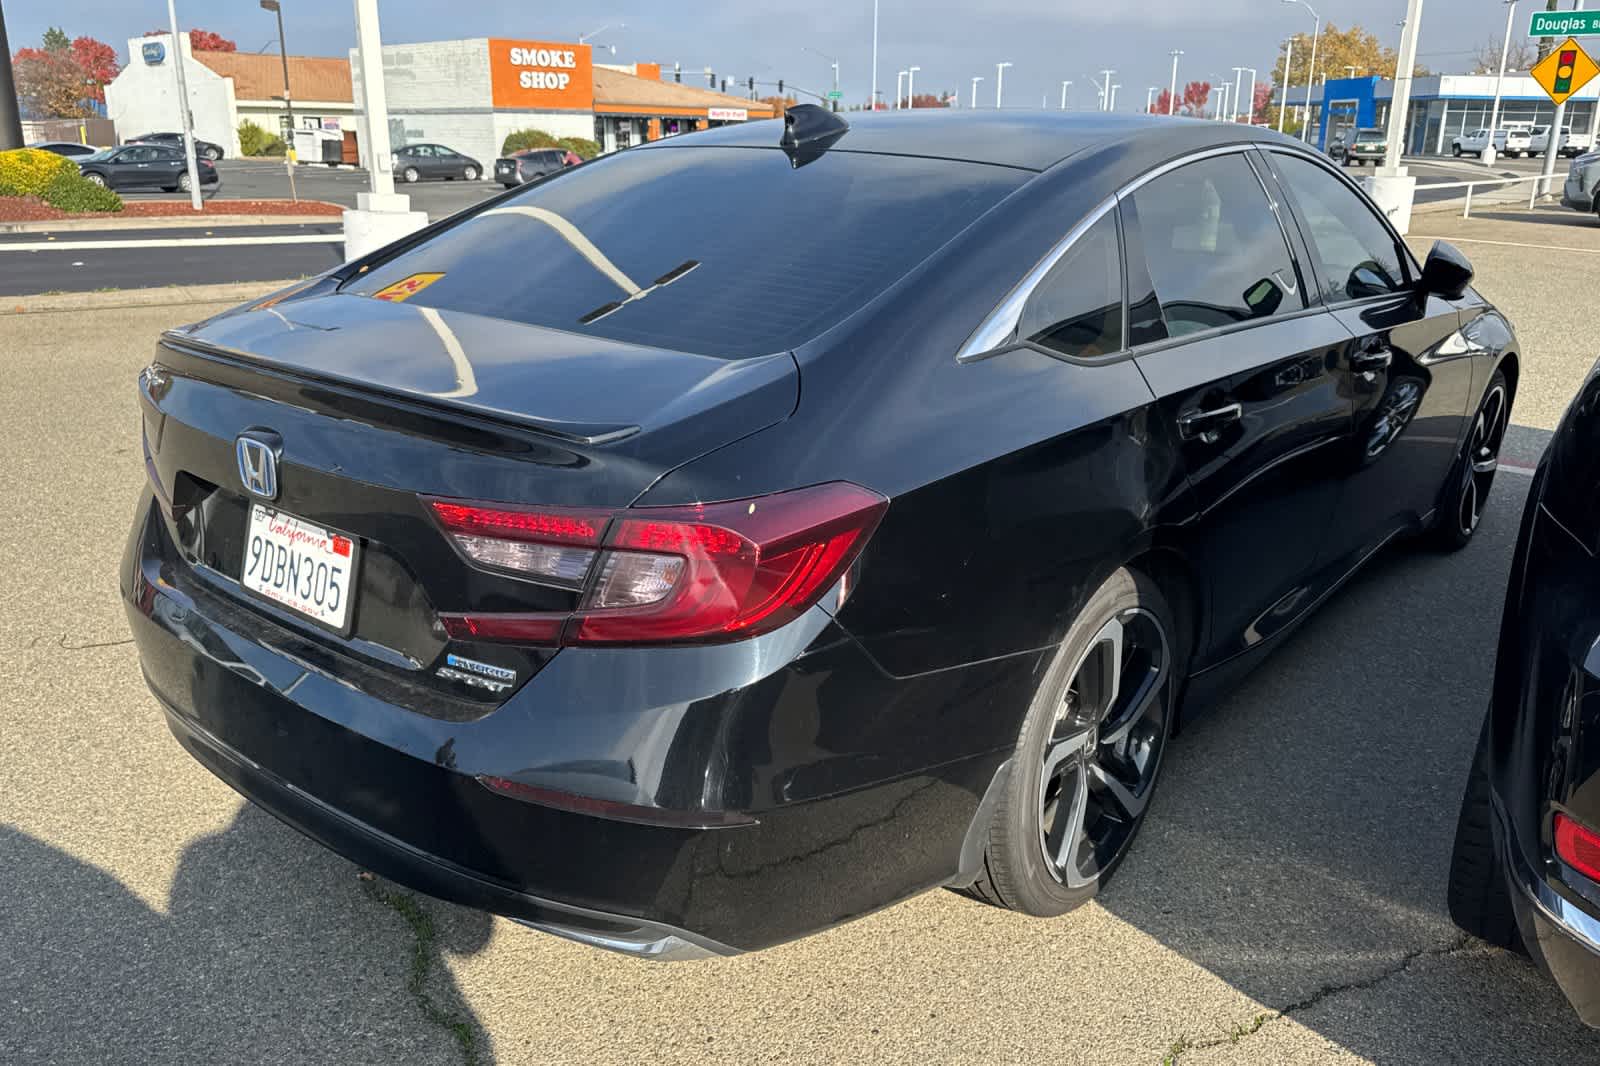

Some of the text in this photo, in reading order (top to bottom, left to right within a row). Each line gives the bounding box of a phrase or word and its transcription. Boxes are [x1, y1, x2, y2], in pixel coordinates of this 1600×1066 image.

[1536, 18, 1586, 33] Douglas
[510, 47, 576, 68] SMOKE
[519, 71, 570, 90] SHOP
[267, 515, 332, 554] California
[247, 535, 342, 612] 9DBN305
